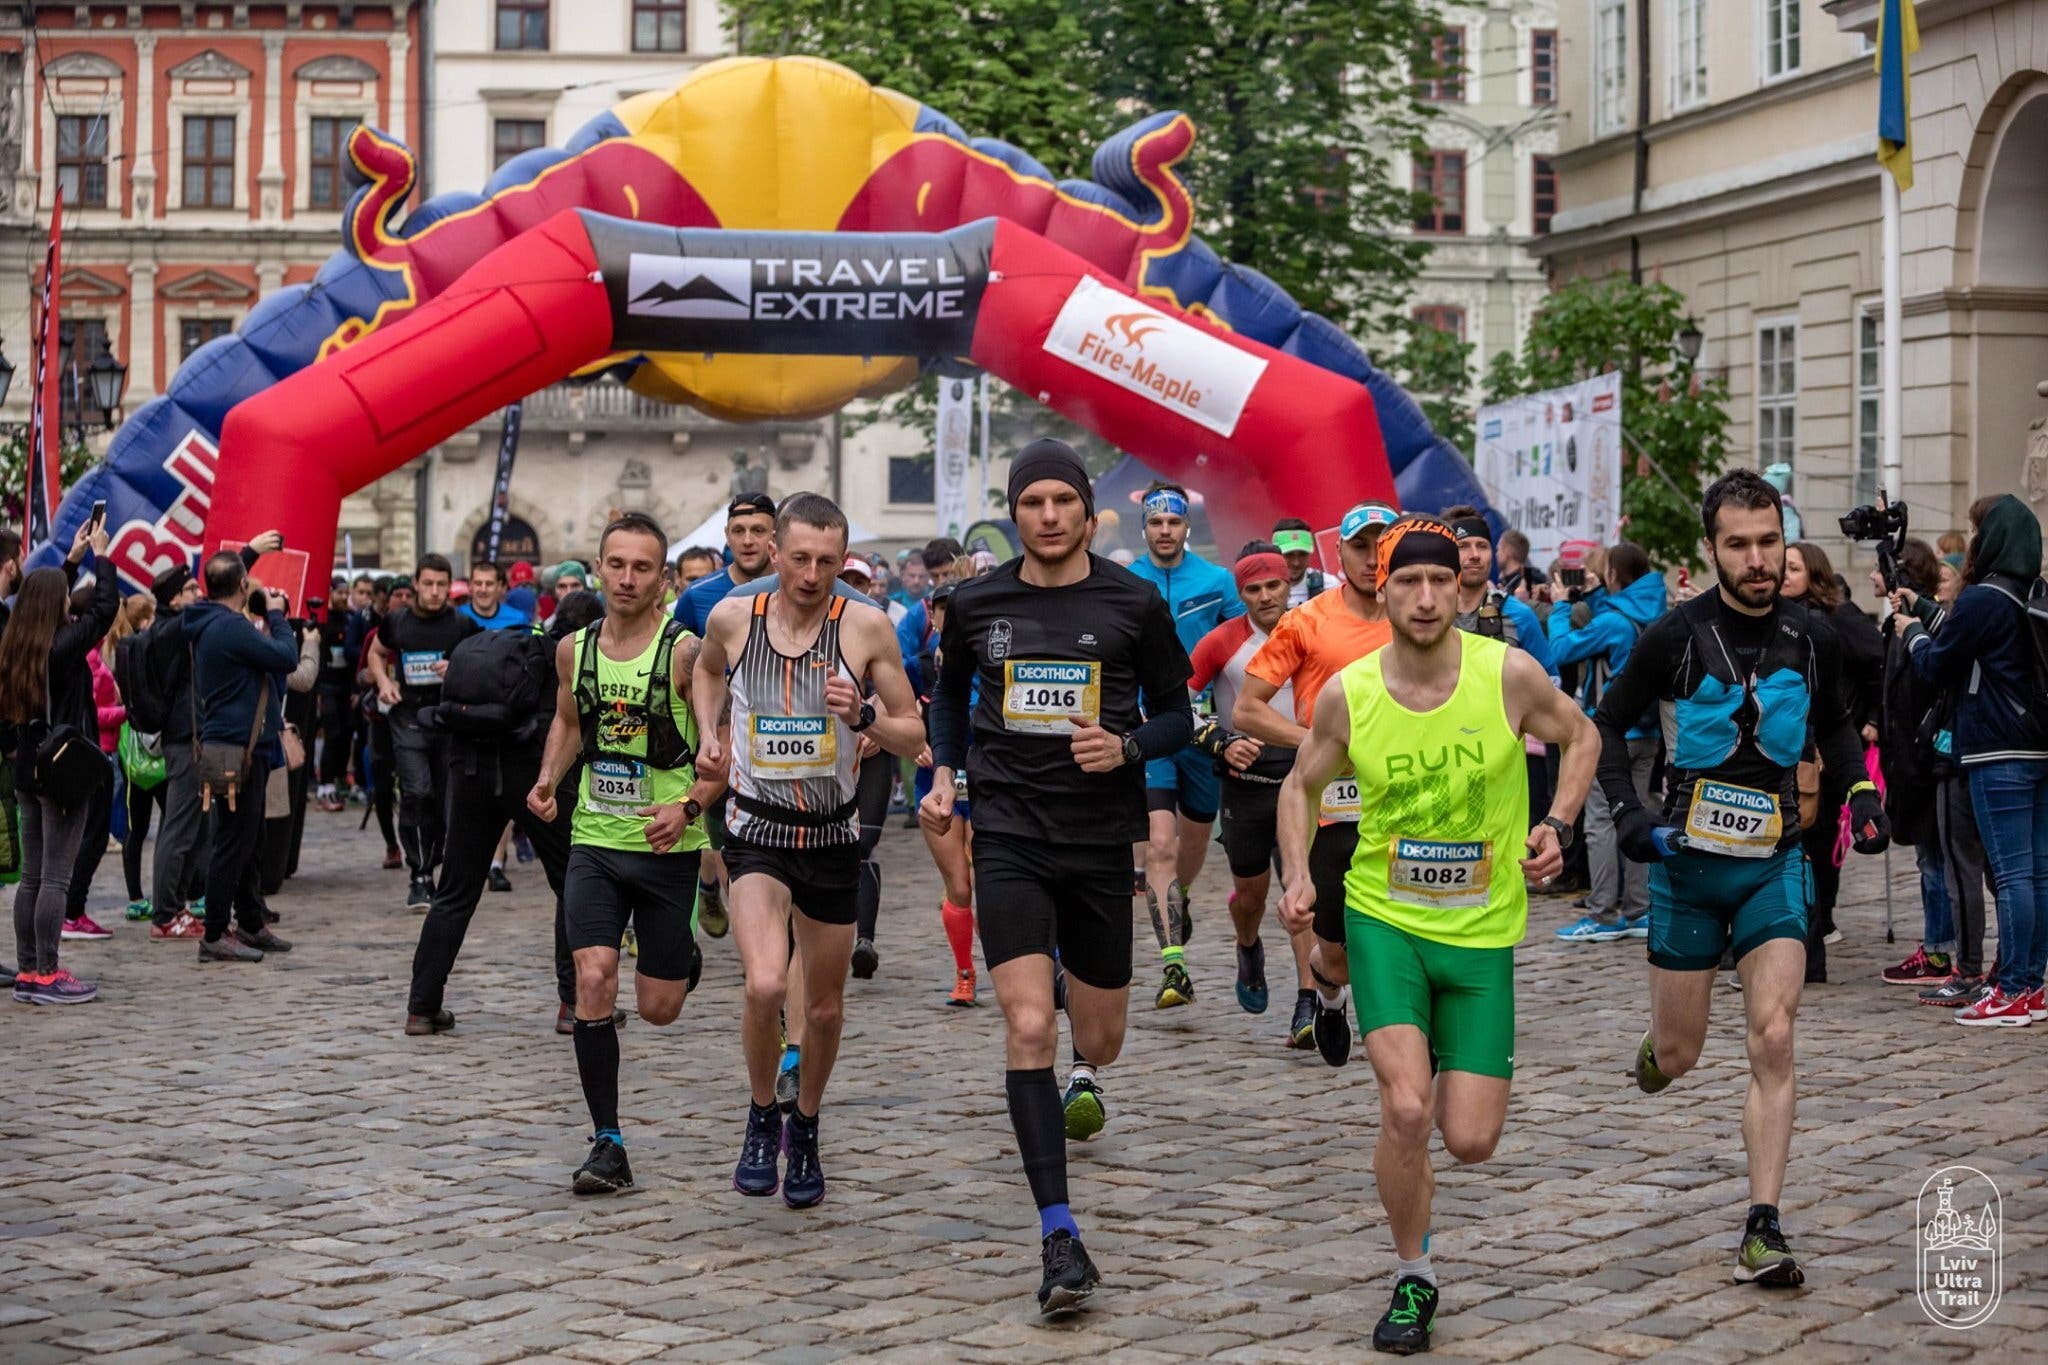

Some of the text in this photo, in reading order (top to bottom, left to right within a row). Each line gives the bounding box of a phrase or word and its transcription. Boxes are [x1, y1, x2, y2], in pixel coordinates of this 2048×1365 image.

[755, 258, 966, 287] TRAVEL
[754, 289, 966, 321] EXTREME
[1077, 333, 1202, 409] Fire-Maple
[107, 431, 219, 594] Bull
[1017, 666, 1087, 681] DECATHLON
[1025, 689, 1076, 706] 1016
[760, 719, 822, 732] DECATHLON
[766, 740, 815, 756] 1006
[1386, 741, 1485, 780] RUN
[598, 778, 636, 796] 2034
[1705, 786, 1773, 811] DECATHLON
[1708, 809, 1763, 834] 1087
[1402, 844, 1479, 859] DECATHLON
[1409, 866, 1467, 884] 1082
